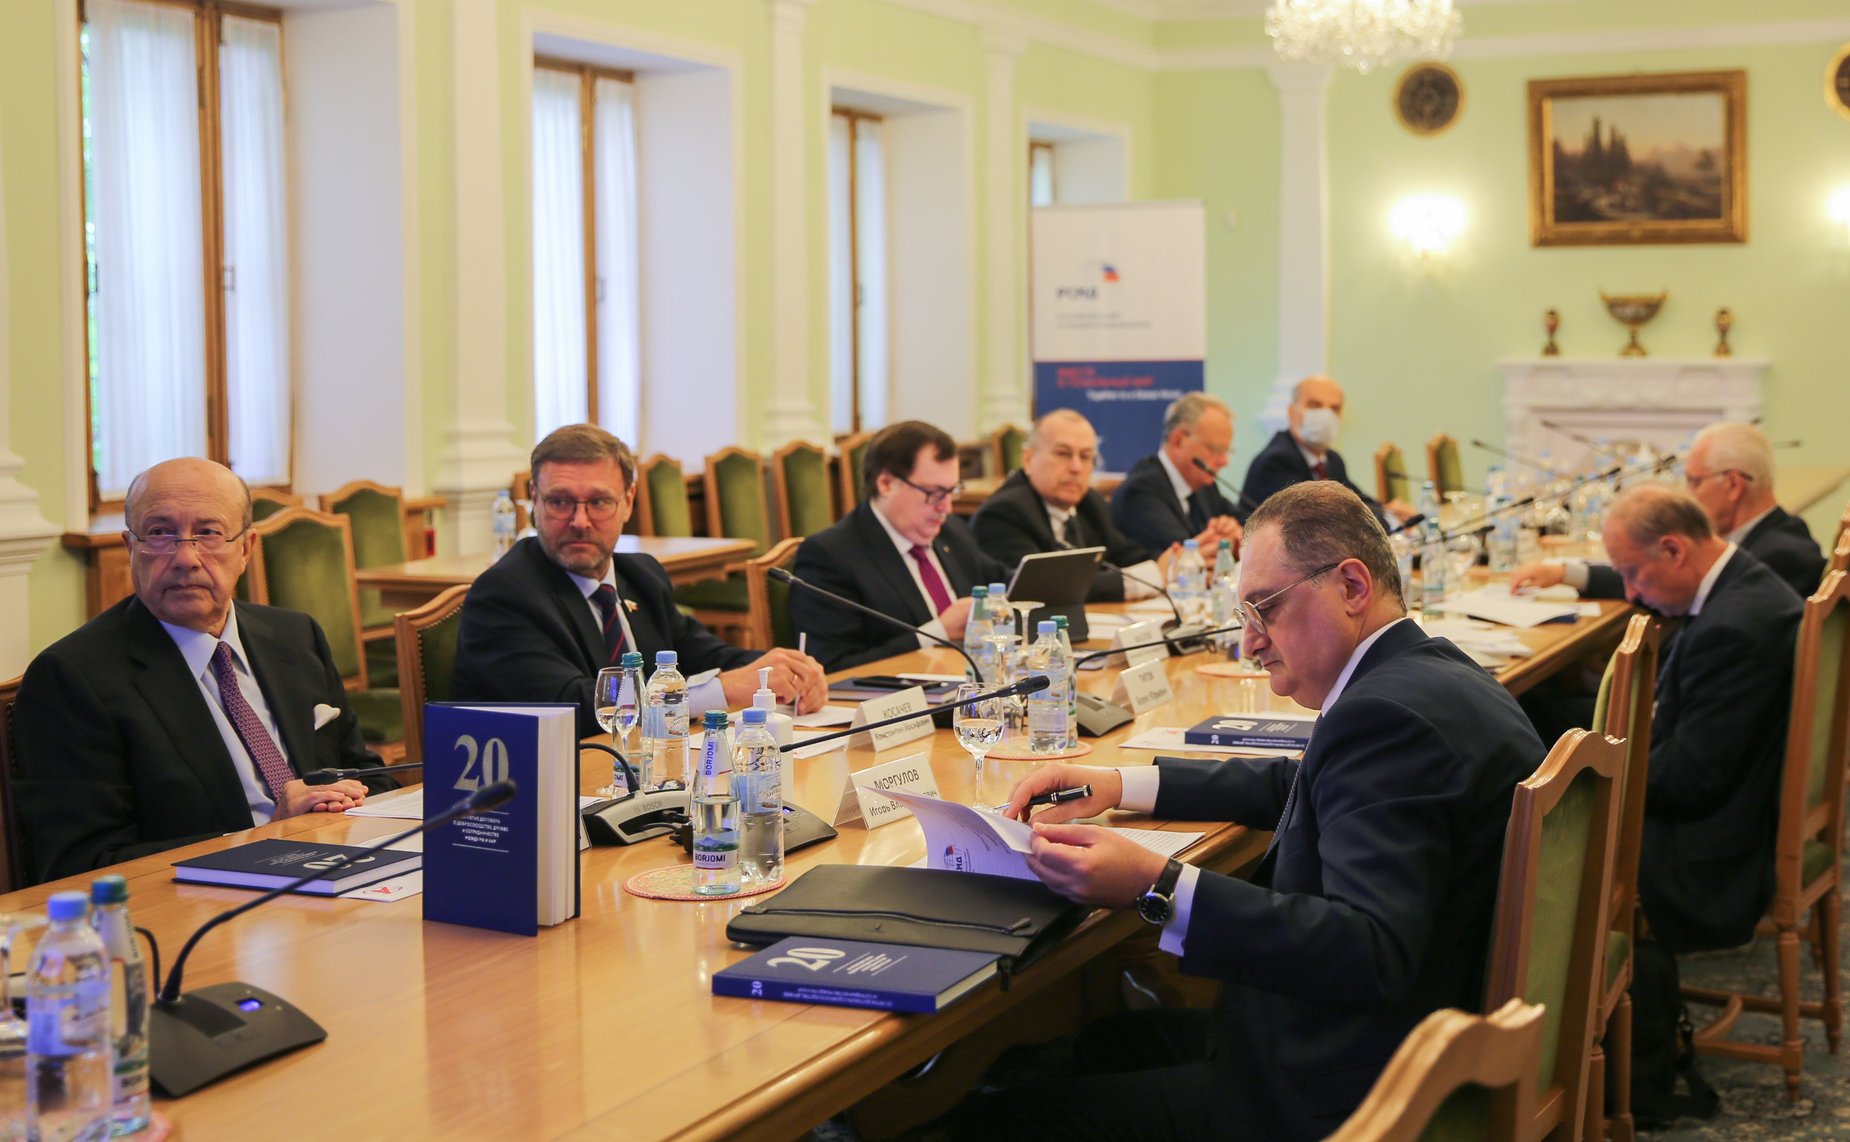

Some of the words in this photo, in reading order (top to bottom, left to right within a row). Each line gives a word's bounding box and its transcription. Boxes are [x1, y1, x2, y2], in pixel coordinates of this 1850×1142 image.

[882, 702, 912, 719] КОСАЧЕВ
[454, 734, 509, 792] 20
[705, 741, 715, 776] BORJOMI
[873, 769, 920, 790] МОРГУЛОВ
[643, 799, 662, 812] BOSCH
[868, 804, 891, 817] Игорь
[695, 853, 726, 863] BORJOMI
[767, 947, 846, 971] 20
[751, 981, 763, 996] 20
